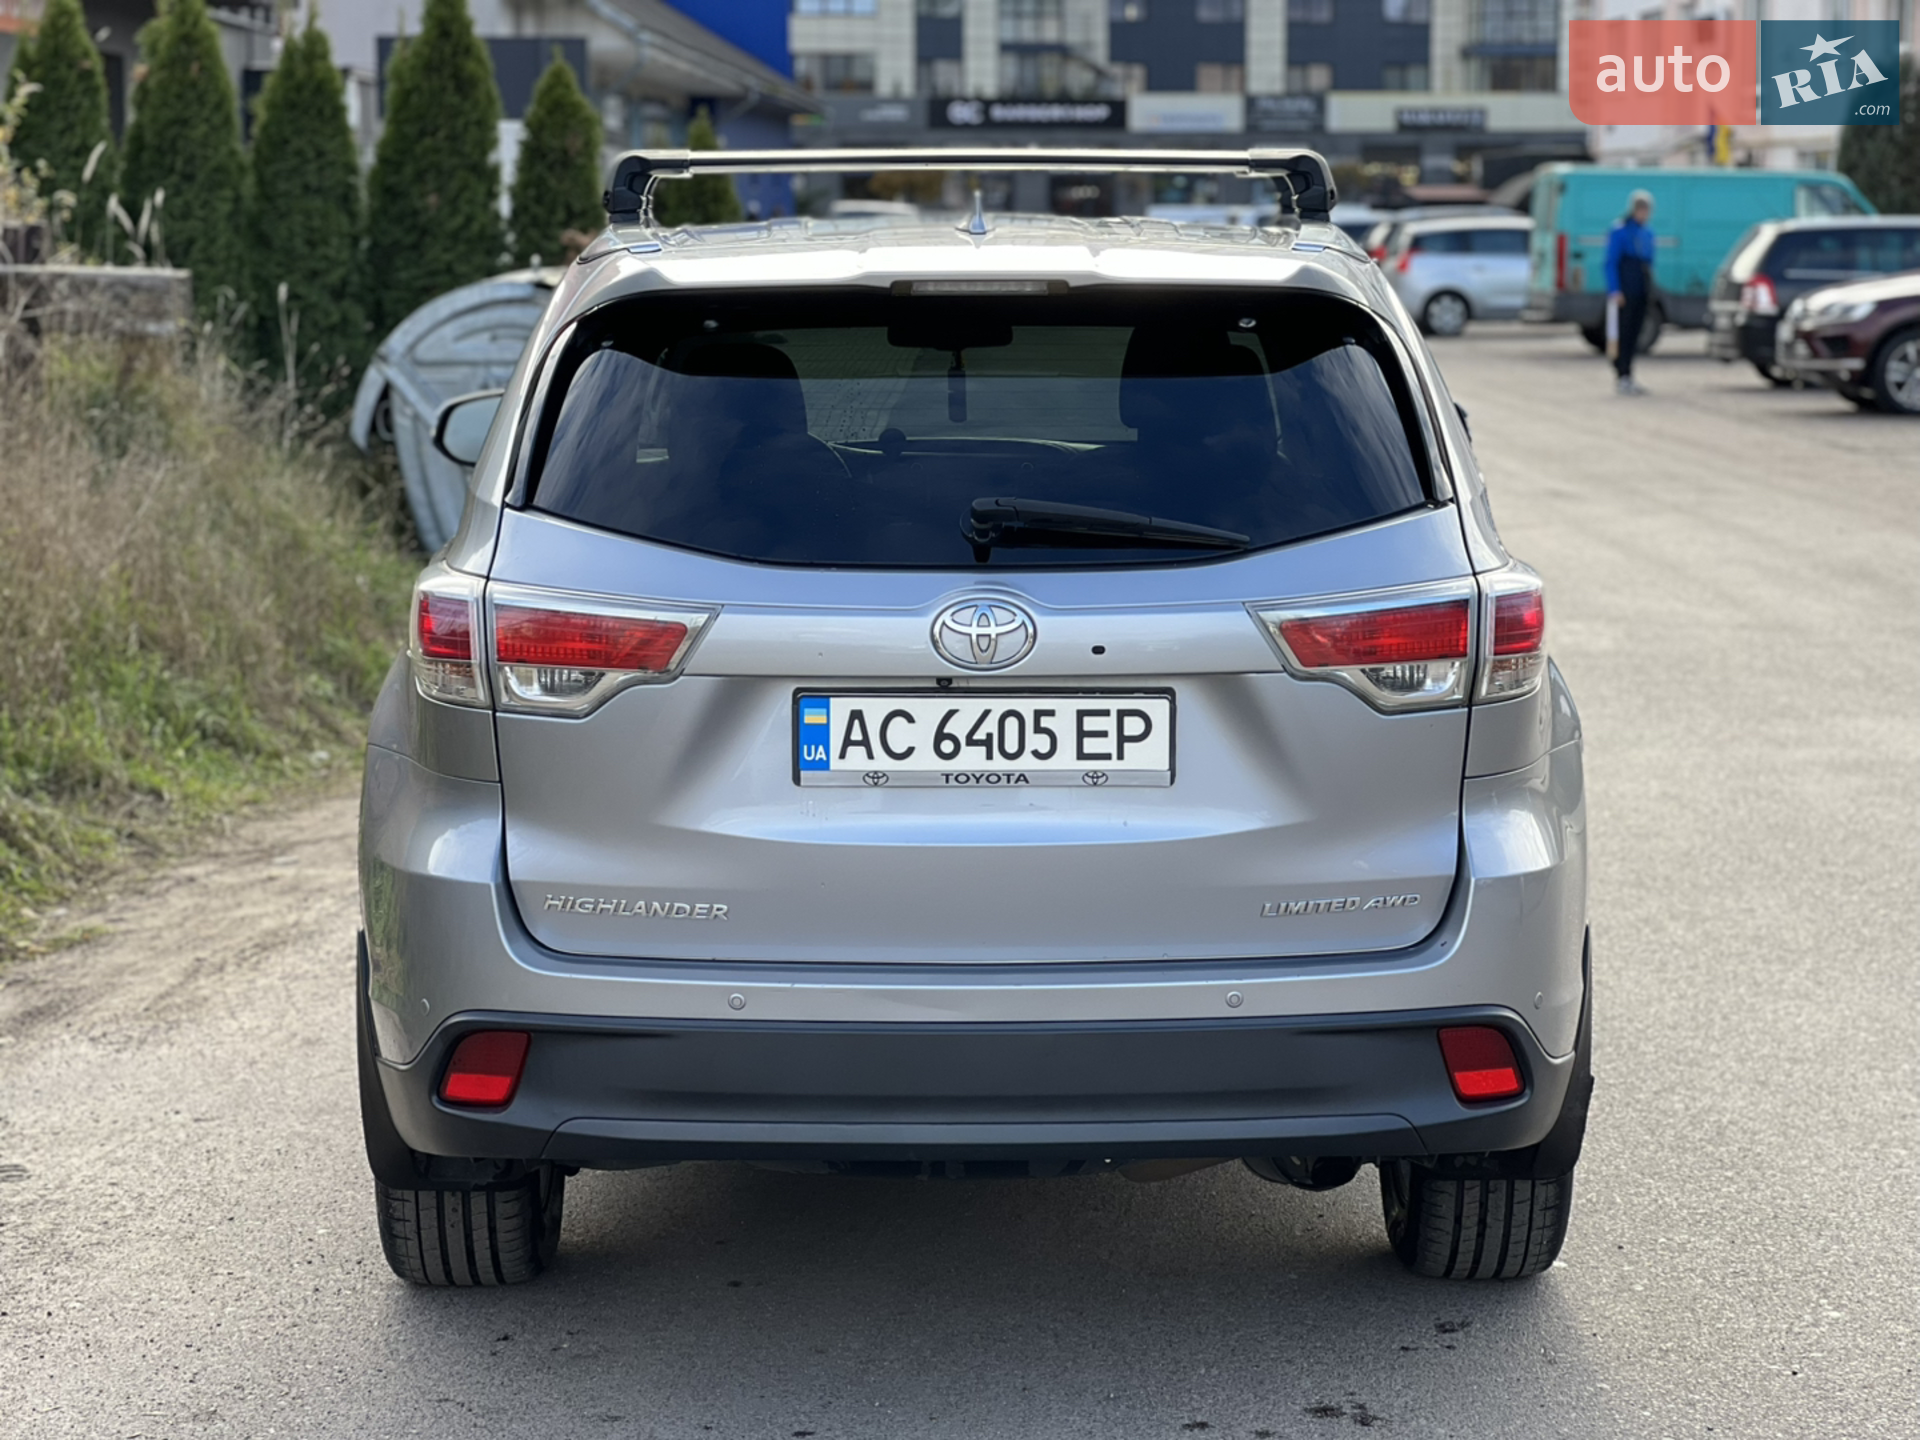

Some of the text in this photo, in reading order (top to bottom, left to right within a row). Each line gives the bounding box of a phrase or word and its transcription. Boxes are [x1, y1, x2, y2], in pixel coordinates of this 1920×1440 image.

[838, 708, 1153, 761] AC 6405 EP
[803, 745, 827, 761] UA
[941, 773, 1030, 785] TOYOTA
[543, 894, 729, 921] HIGHLANDER
[1261, 894, 1421, 917] LIMITED AWD
